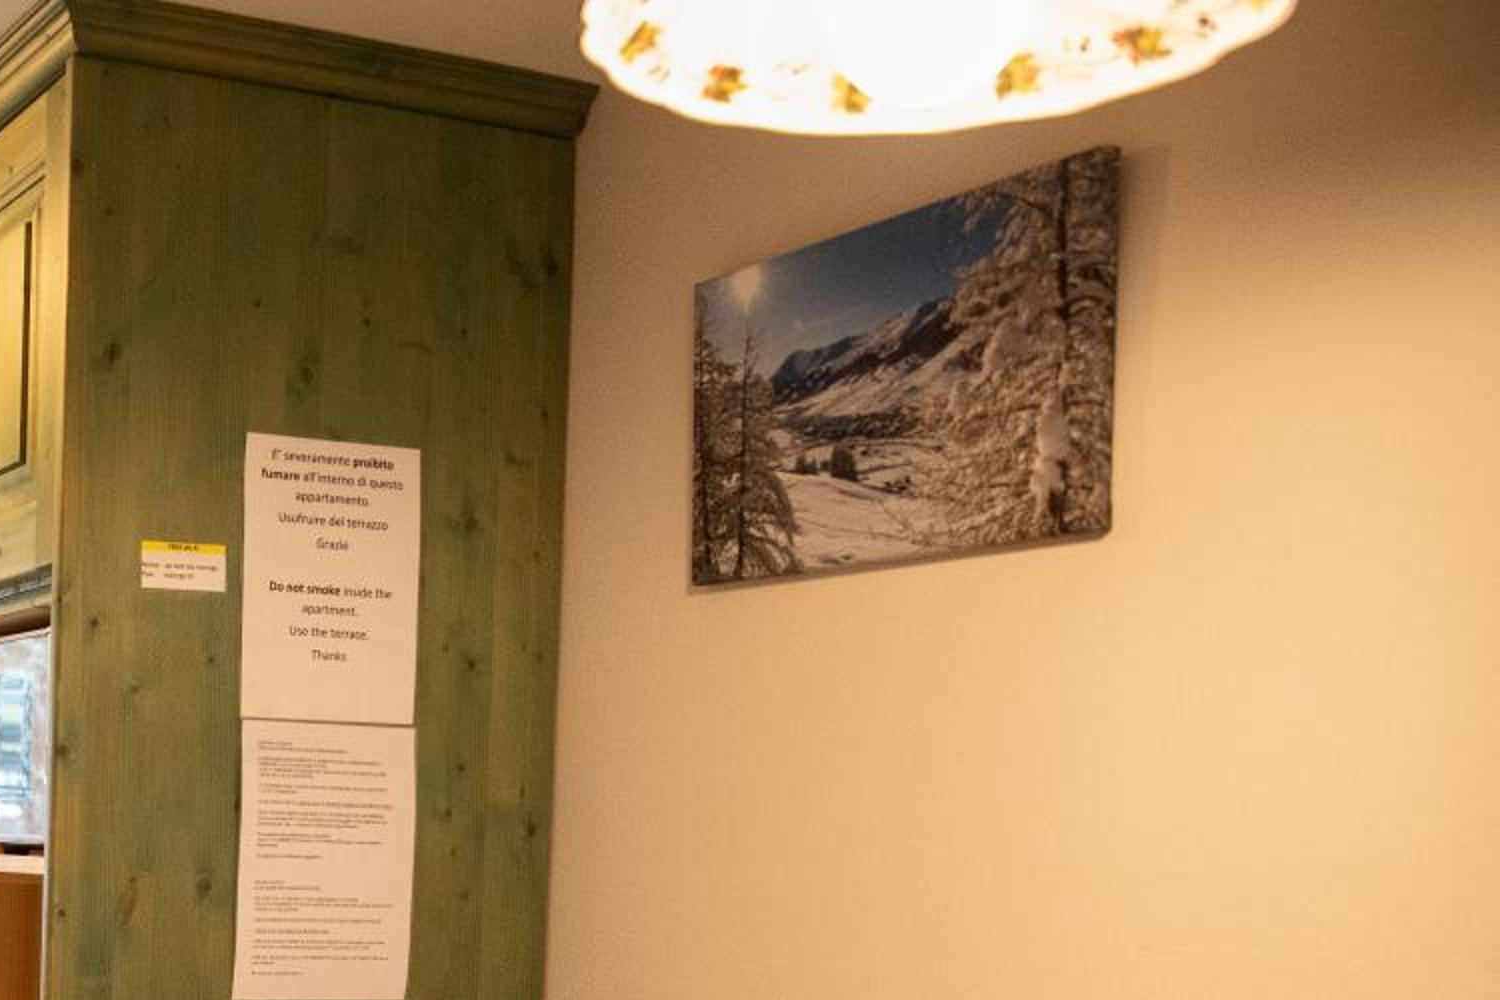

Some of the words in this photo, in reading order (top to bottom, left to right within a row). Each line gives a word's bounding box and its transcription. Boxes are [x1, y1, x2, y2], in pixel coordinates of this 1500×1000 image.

[284, 451, 350, 466] severamente
[353, 457, 395, 471] proibito
[261, 467, 300, 480] fumare
[357, 476, 366, 487] di
[369, 479, 404, 491] questo
[278, 512, 327, 526] Usufruire
[347, 518, 389, 531] terrazzo
[316, 537, 349, 550] Grazie
[269, 580, 283, 592] Do
[286, 583, 305, 593] not
[307, 584, 341, 596] smoke
[343, 587, 372, 598] inside
[375, 588, 393, 599] the
[311, 626, 328, 638] the
[312, 649, 347, 662] Thanks
